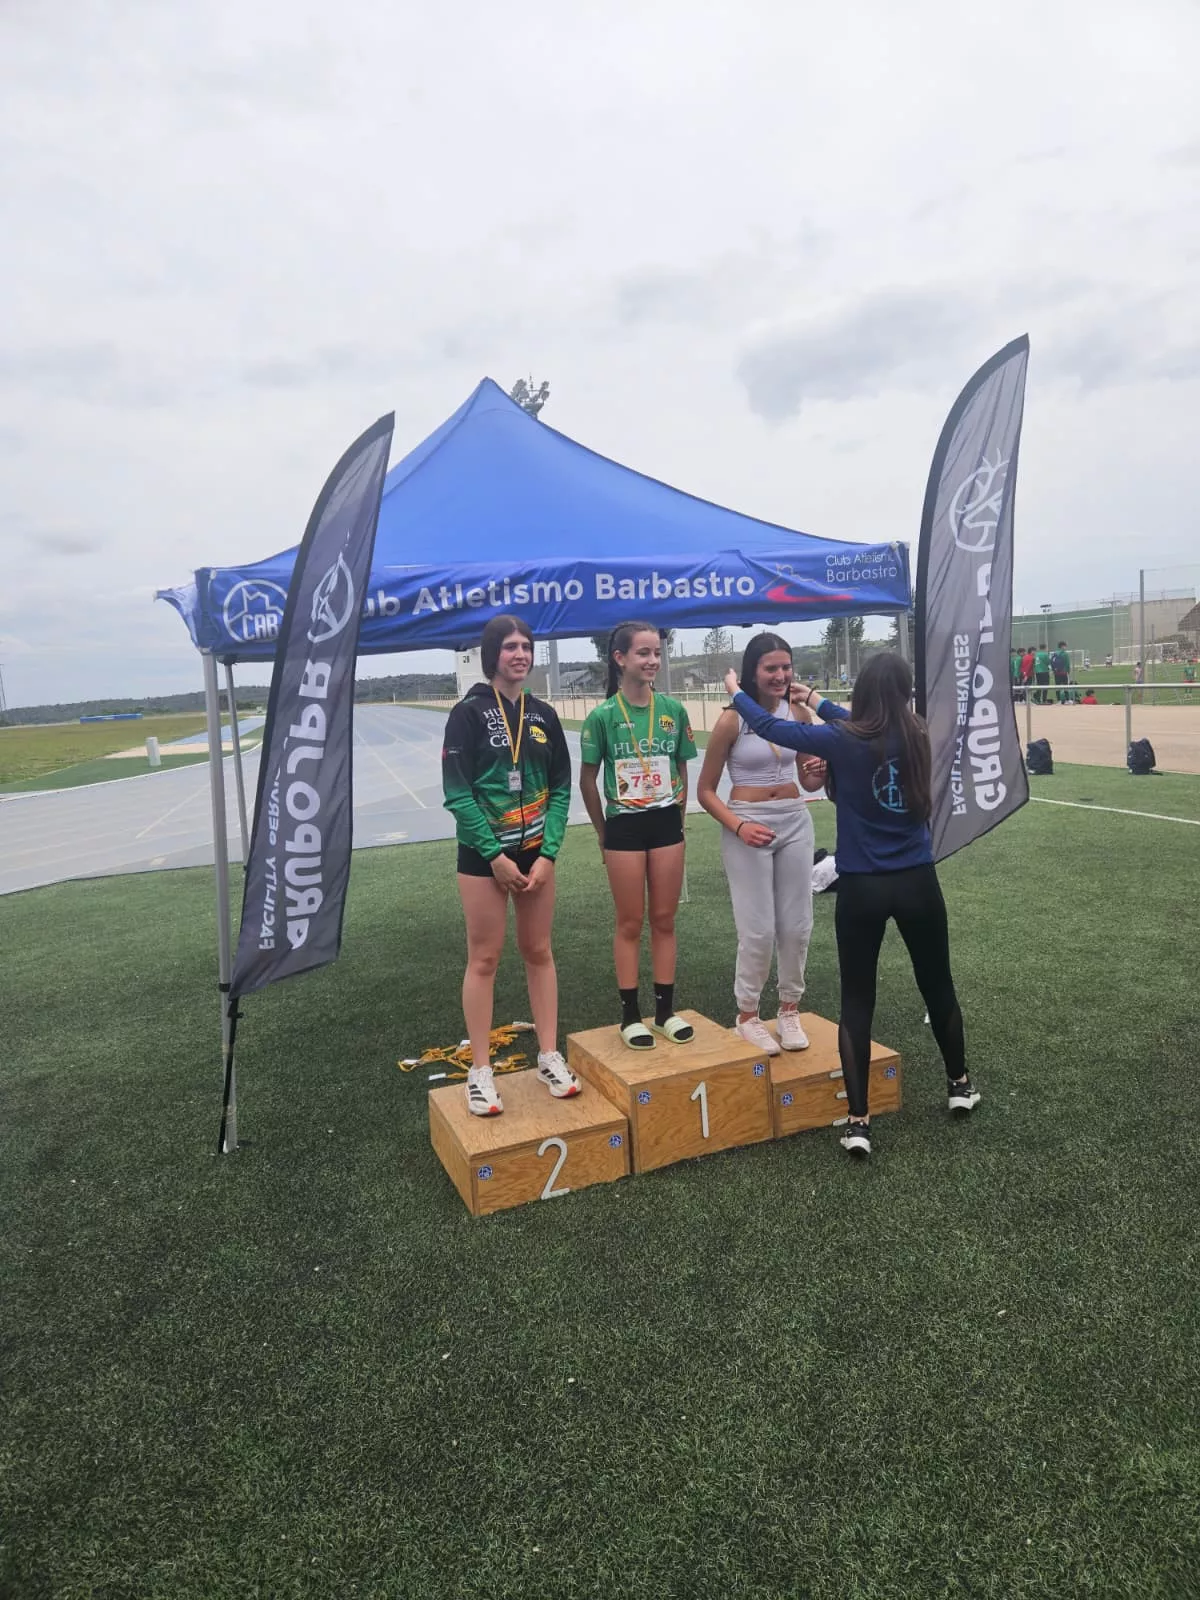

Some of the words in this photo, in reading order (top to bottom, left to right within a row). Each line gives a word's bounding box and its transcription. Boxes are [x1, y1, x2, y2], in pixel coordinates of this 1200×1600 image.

[825, 554, 851, 567] Club
[826, 566, 898, 583] Barbastro
[412, 578, 584, 616] Atletismo
[595, 572, 756, 600] Barbastro
[690, 1082, 710, 1138] 1
[537, 1137, 571, 1200] 2
